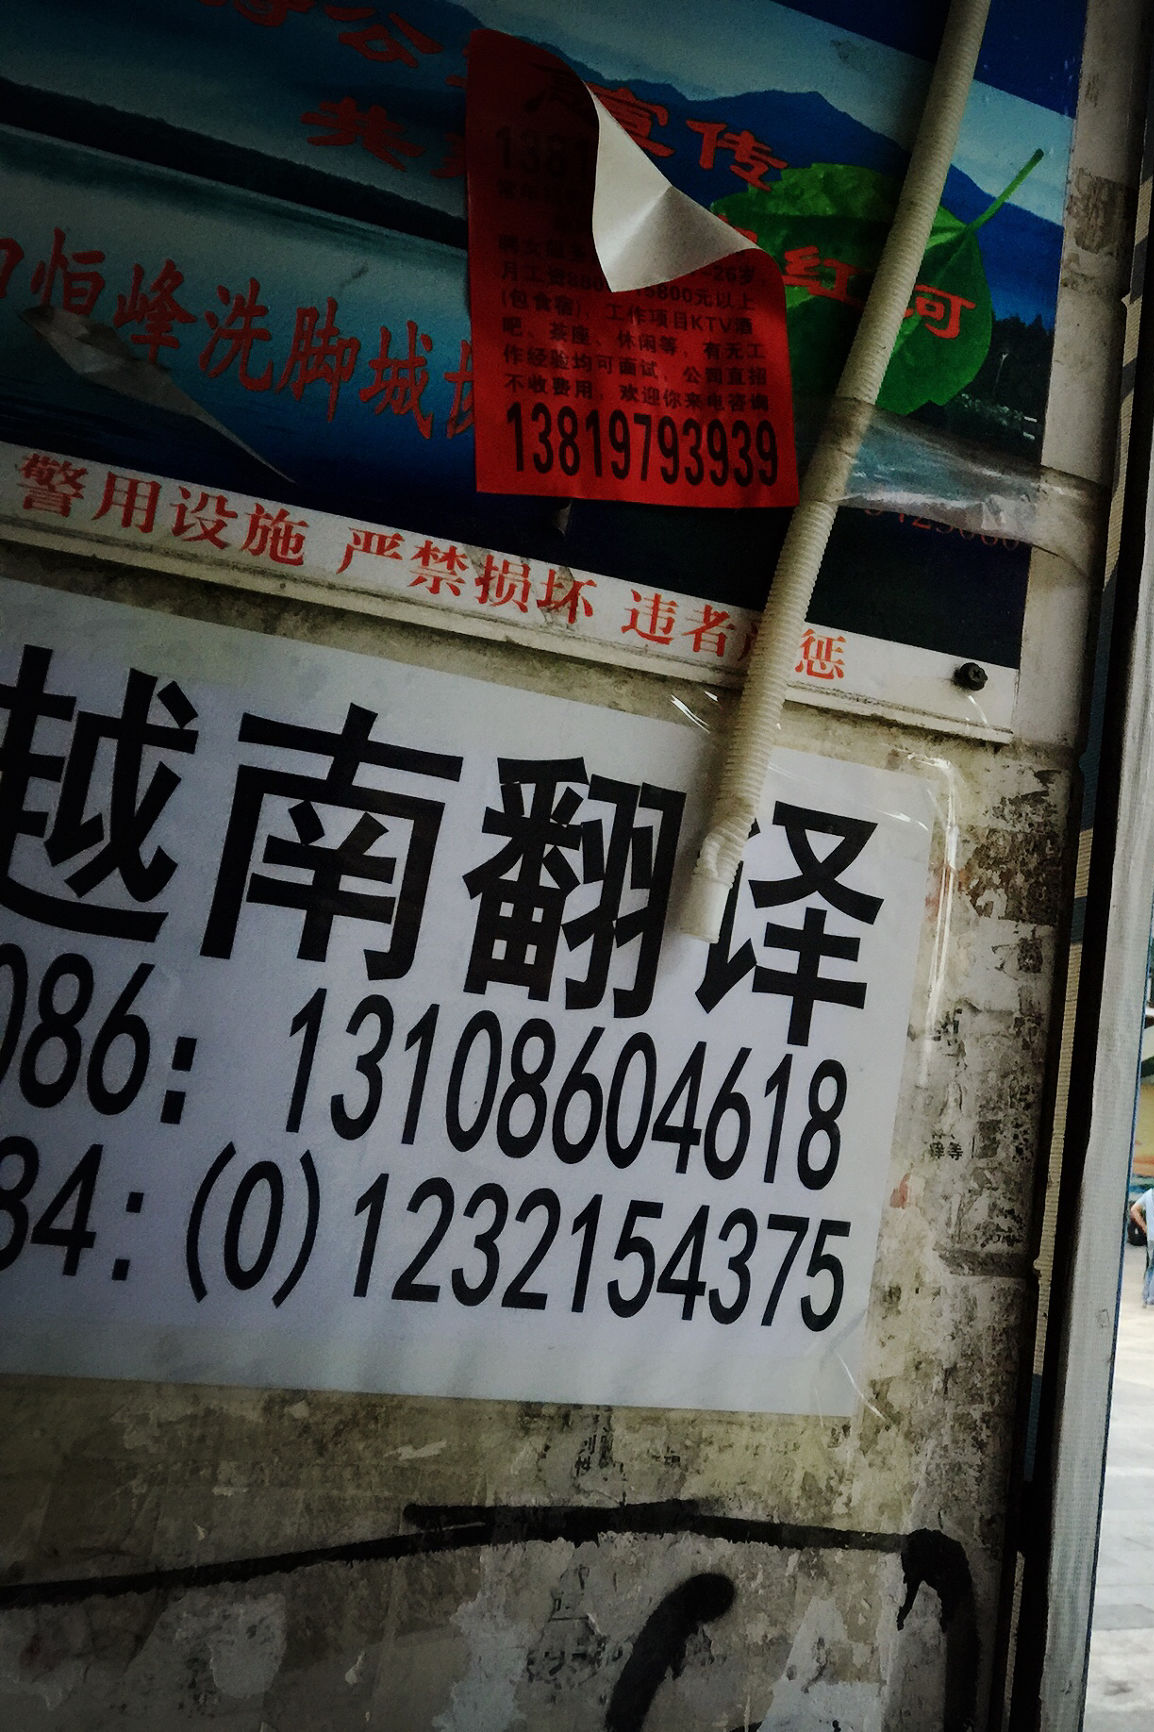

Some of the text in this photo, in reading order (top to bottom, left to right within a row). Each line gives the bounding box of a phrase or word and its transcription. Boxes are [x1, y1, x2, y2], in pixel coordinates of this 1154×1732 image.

[507, 401, 779, 488] 13819793939
[15, 452, 308, 568] 警用设施
[336, 526, 597, 632] 严禁损坏
[0, 644, 886, 1048] 越南翻译
[286, 987, 849, 1191] 13108604618
